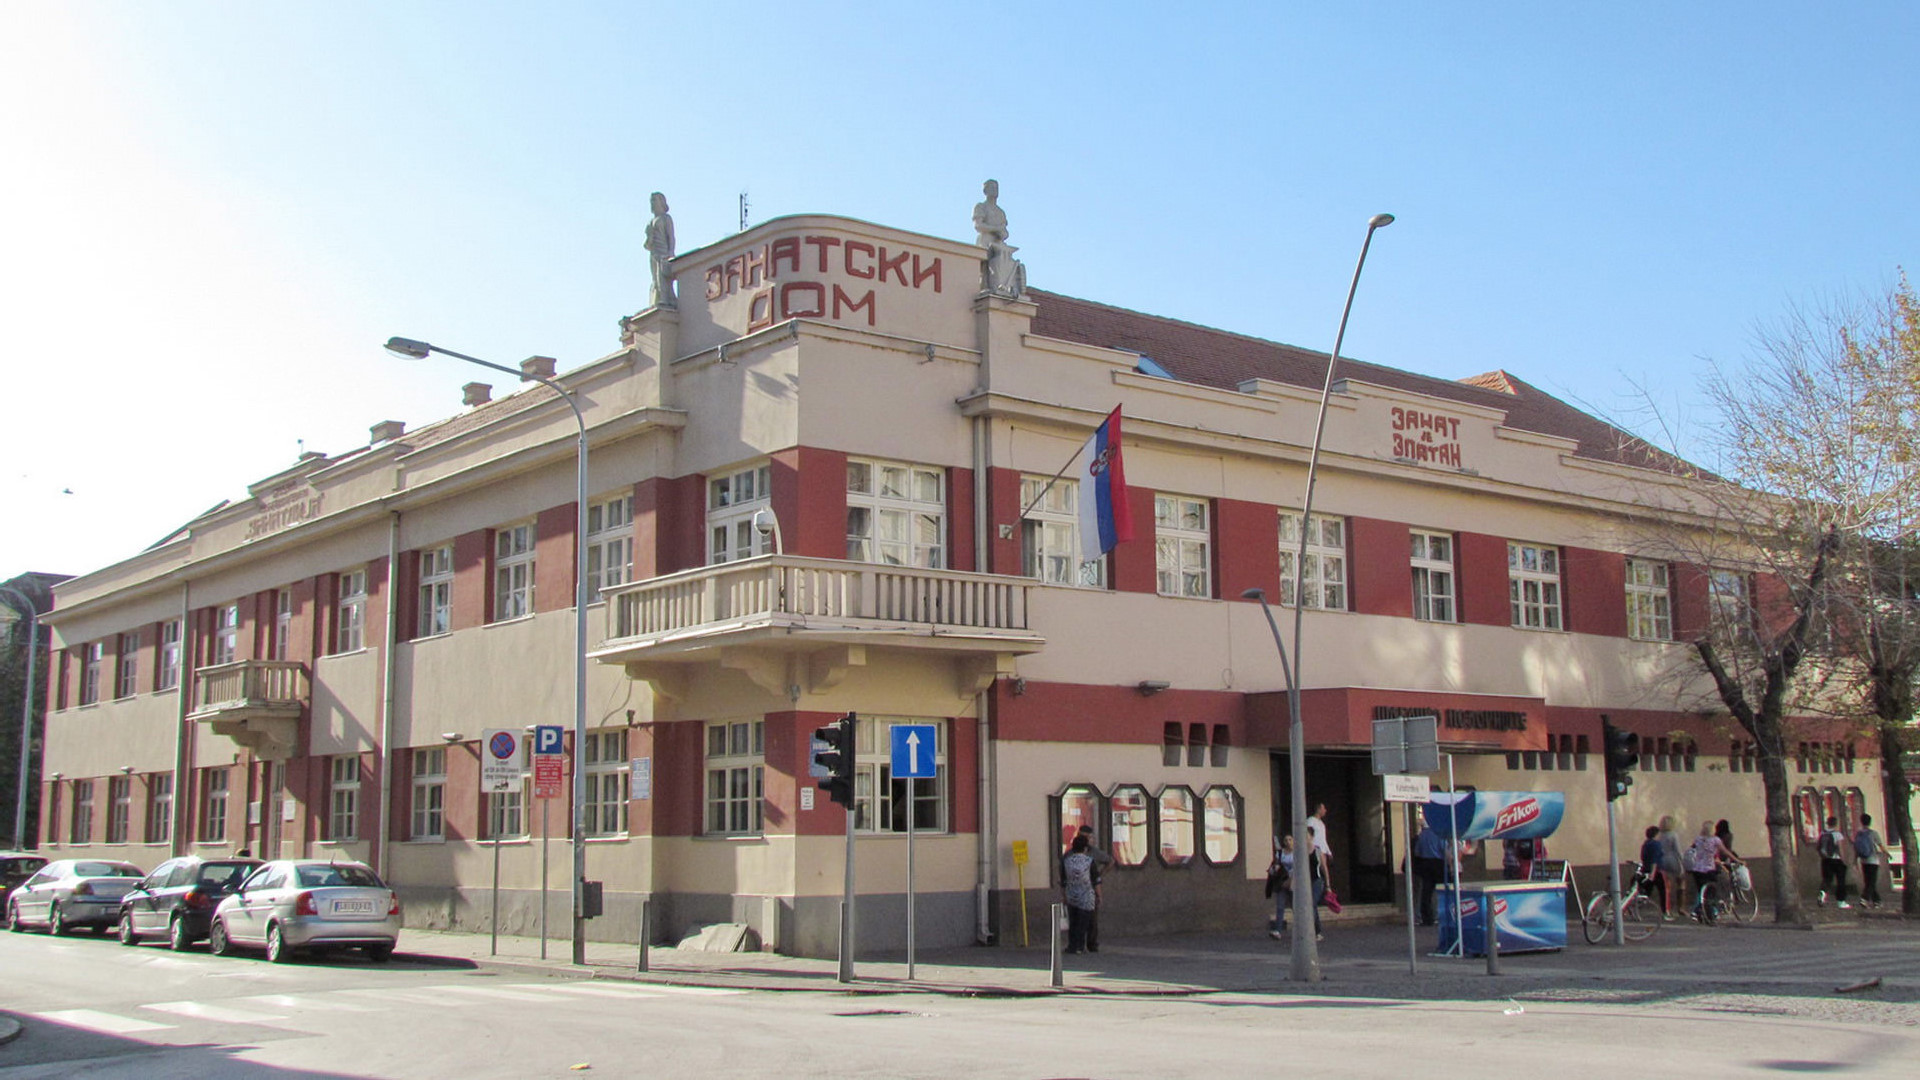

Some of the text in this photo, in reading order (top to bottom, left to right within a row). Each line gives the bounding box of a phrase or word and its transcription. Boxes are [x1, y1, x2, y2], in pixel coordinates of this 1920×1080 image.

[705, 235, 942, 299] ЗАНАТСКИ
[747, 281, 875, 334] ДОМ
[1391, 407, 1461, 440] ЗАНАТ
[541, 729, 557, 751] P
